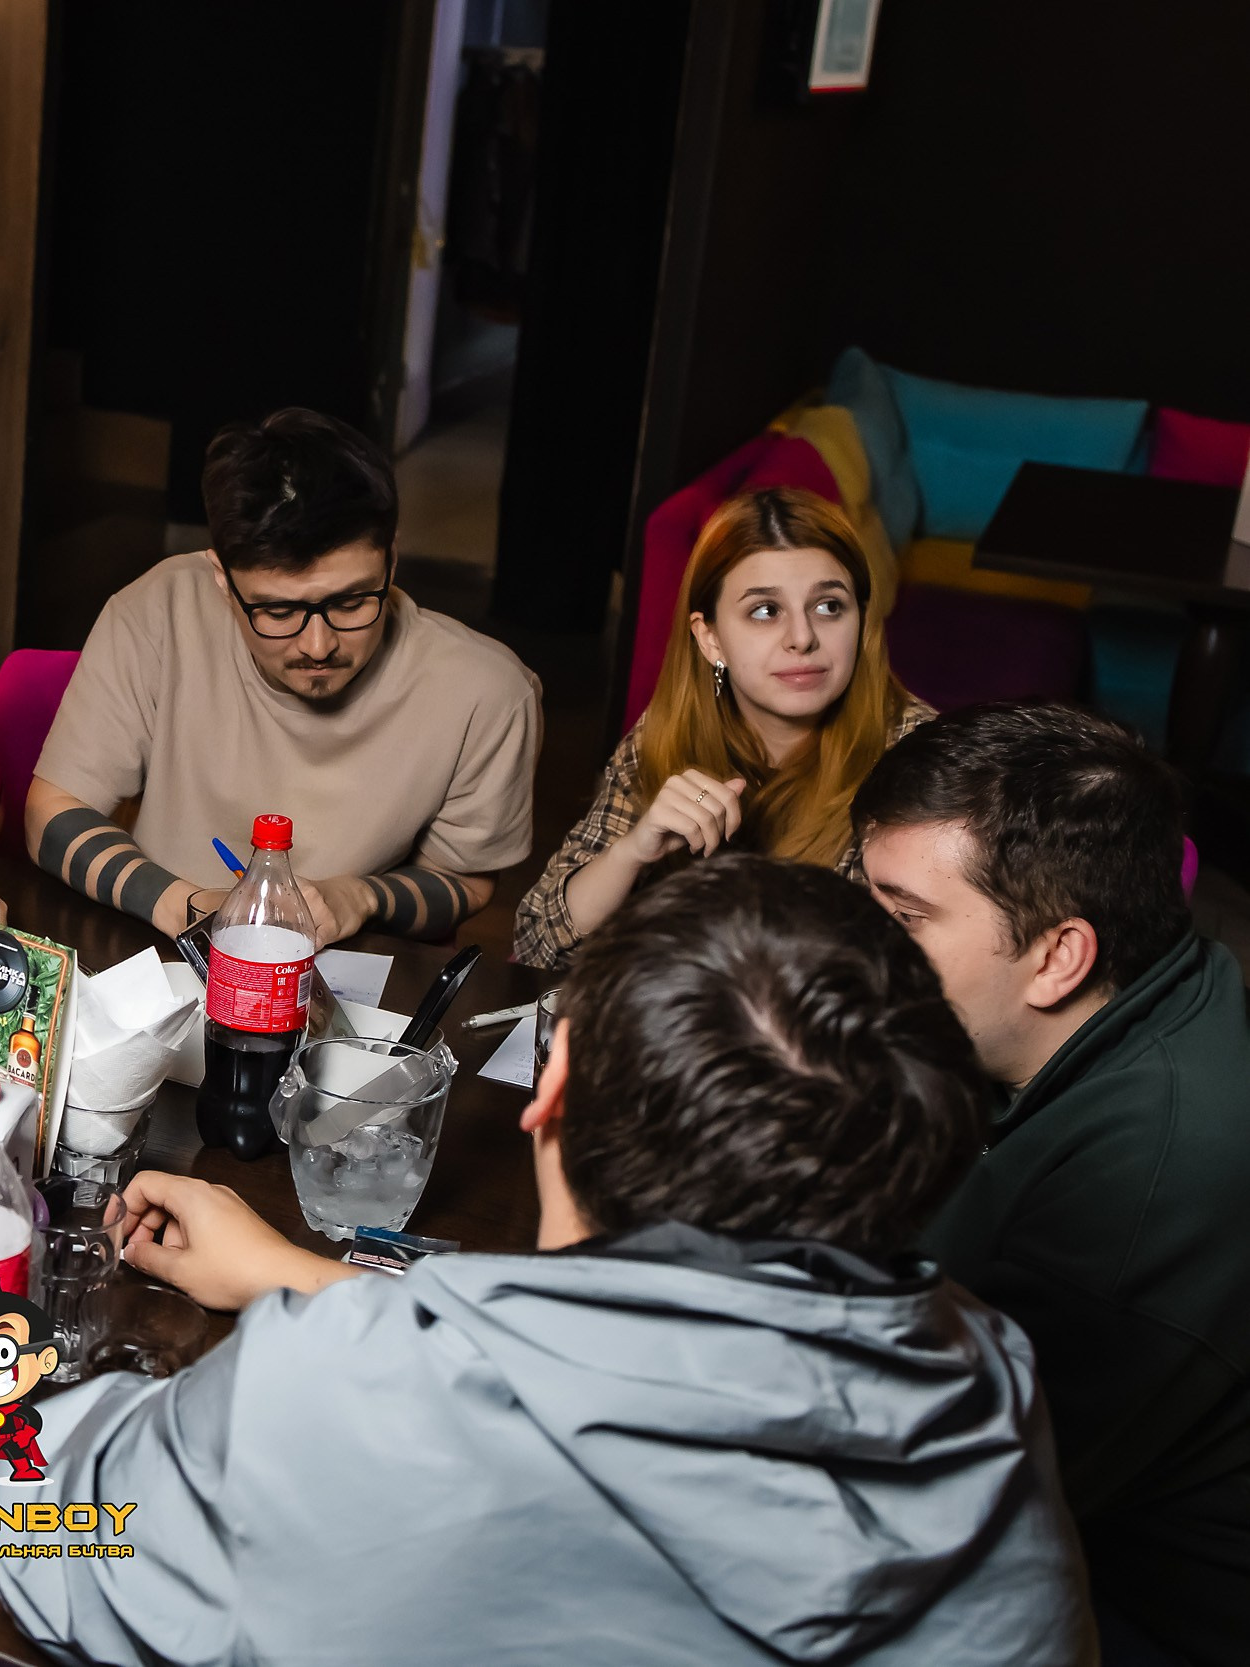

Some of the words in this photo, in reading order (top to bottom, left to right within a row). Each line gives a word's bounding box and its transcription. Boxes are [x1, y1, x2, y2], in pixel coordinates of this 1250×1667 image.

[275, 965, 298, 975] Coke
[10, 975, 26, 987] ТЫ
[7, 1064, 36, 1082] BACARD
